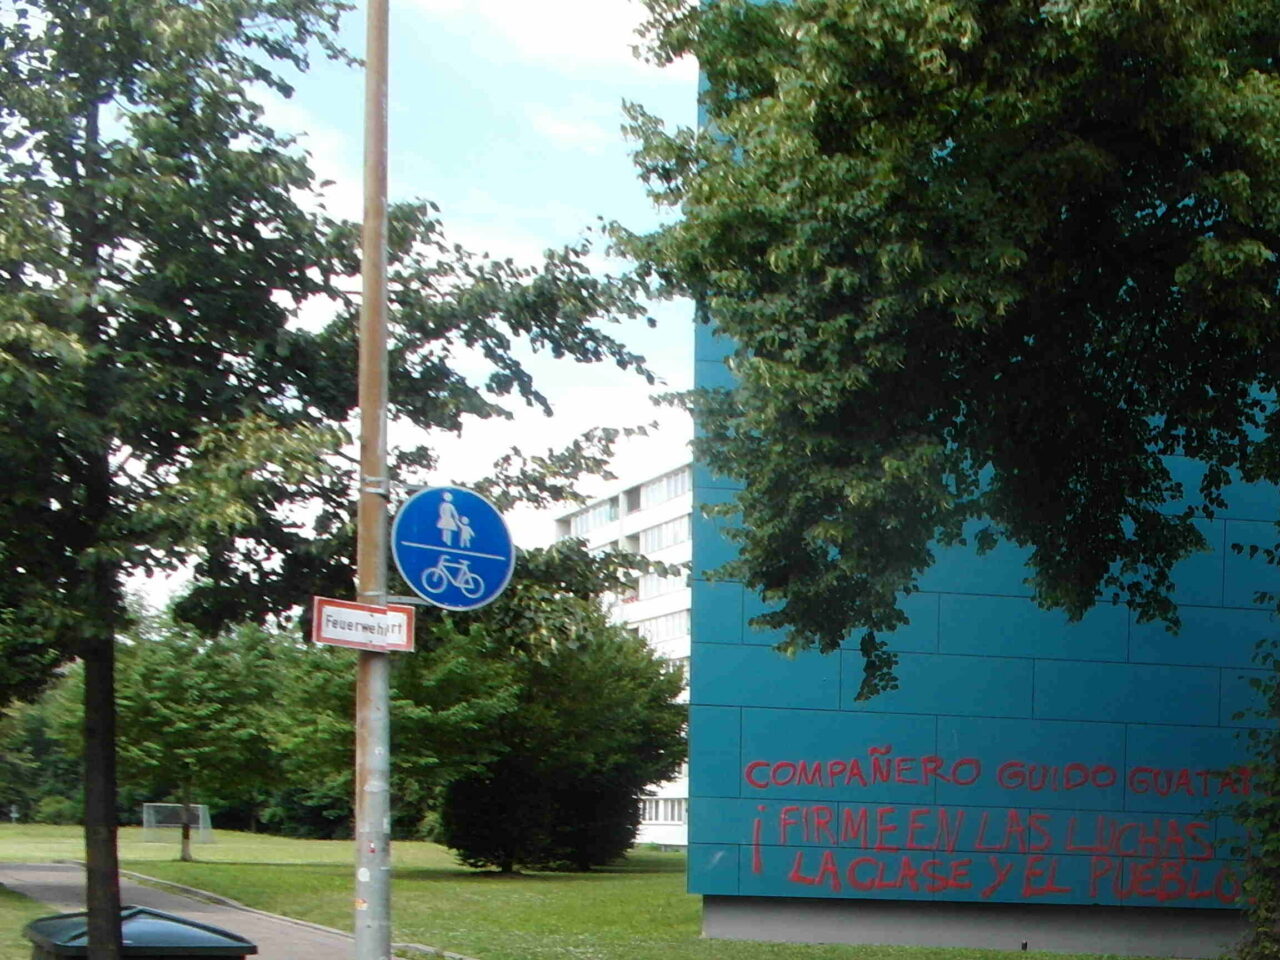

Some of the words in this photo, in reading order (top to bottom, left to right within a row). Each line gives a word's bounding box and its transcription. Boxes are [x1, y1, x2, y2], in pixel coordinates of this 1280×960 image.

[745, 745, 981, 788] COMPAÑERO
[997, 760, 1116, 791] GUIDO
[974, 811, 1052, 852] LAS
[1065, 815, 1215, 863] LUCHAS
[981, 855, 1012, 898] Y
[1022, 859, 1071, 897] EL
